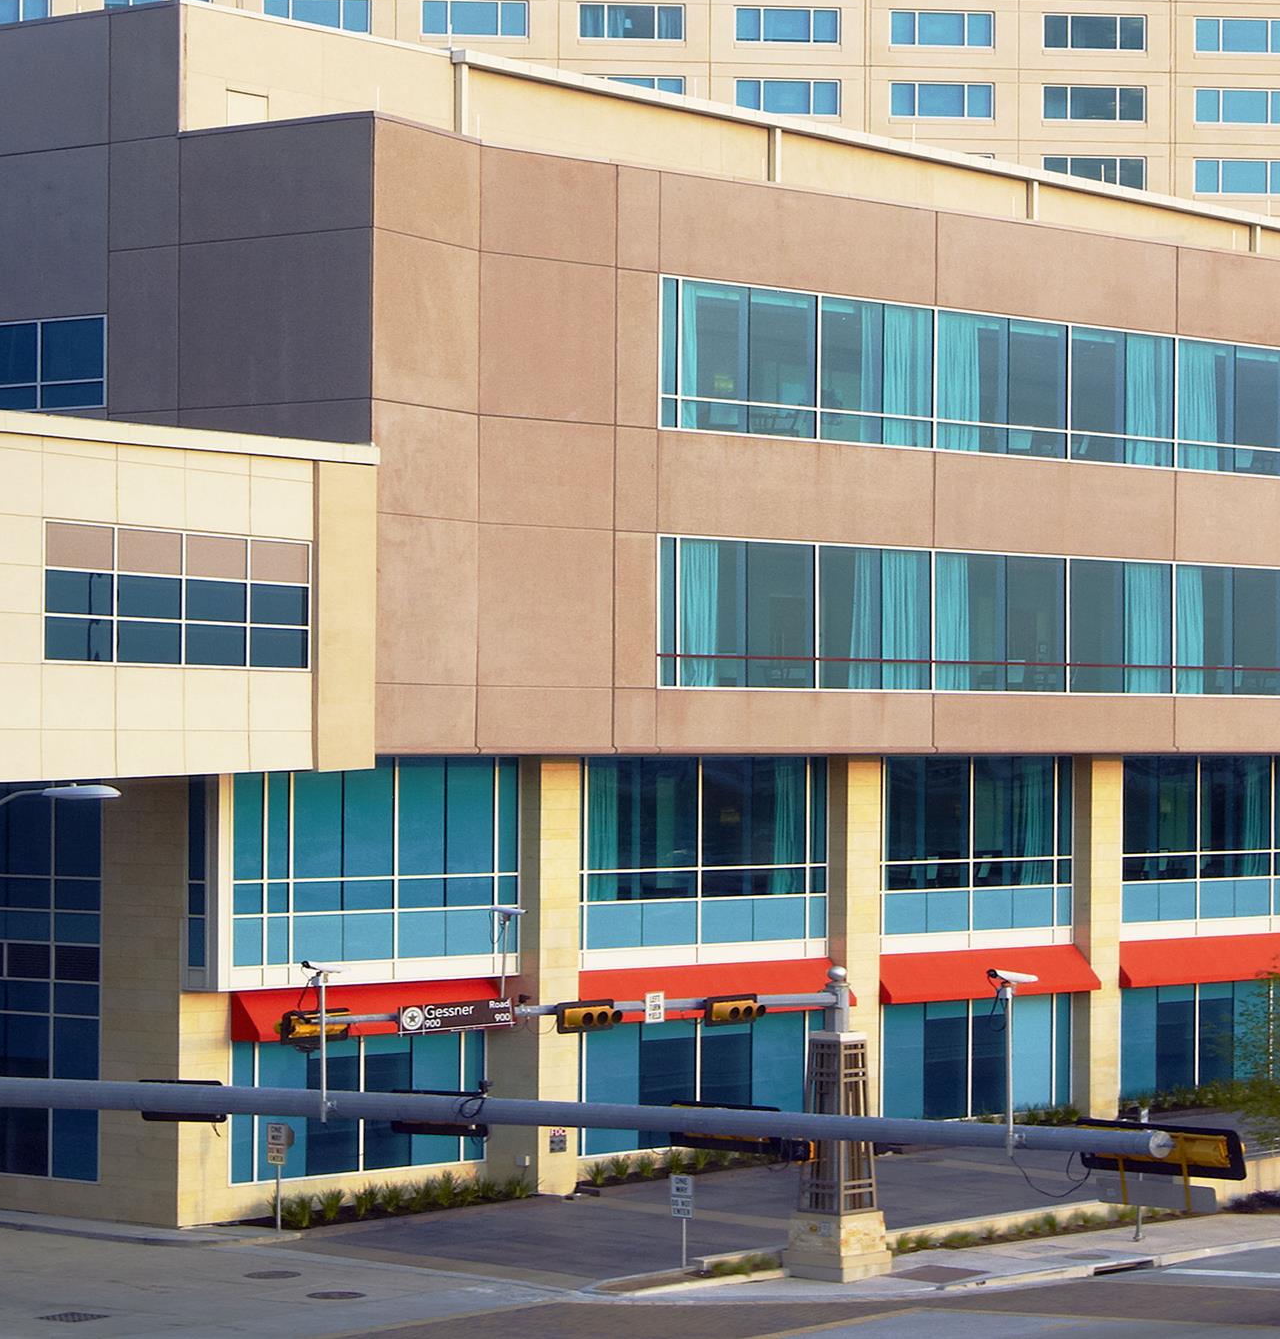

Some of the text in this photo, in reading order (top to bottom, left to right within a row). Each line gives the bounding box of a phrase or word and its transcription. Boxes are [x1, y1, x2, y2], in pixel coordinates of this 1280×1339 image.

[424, 1000, 510, 1019] Gessner Road
[425, 1013, 511, 1028] 900 900
